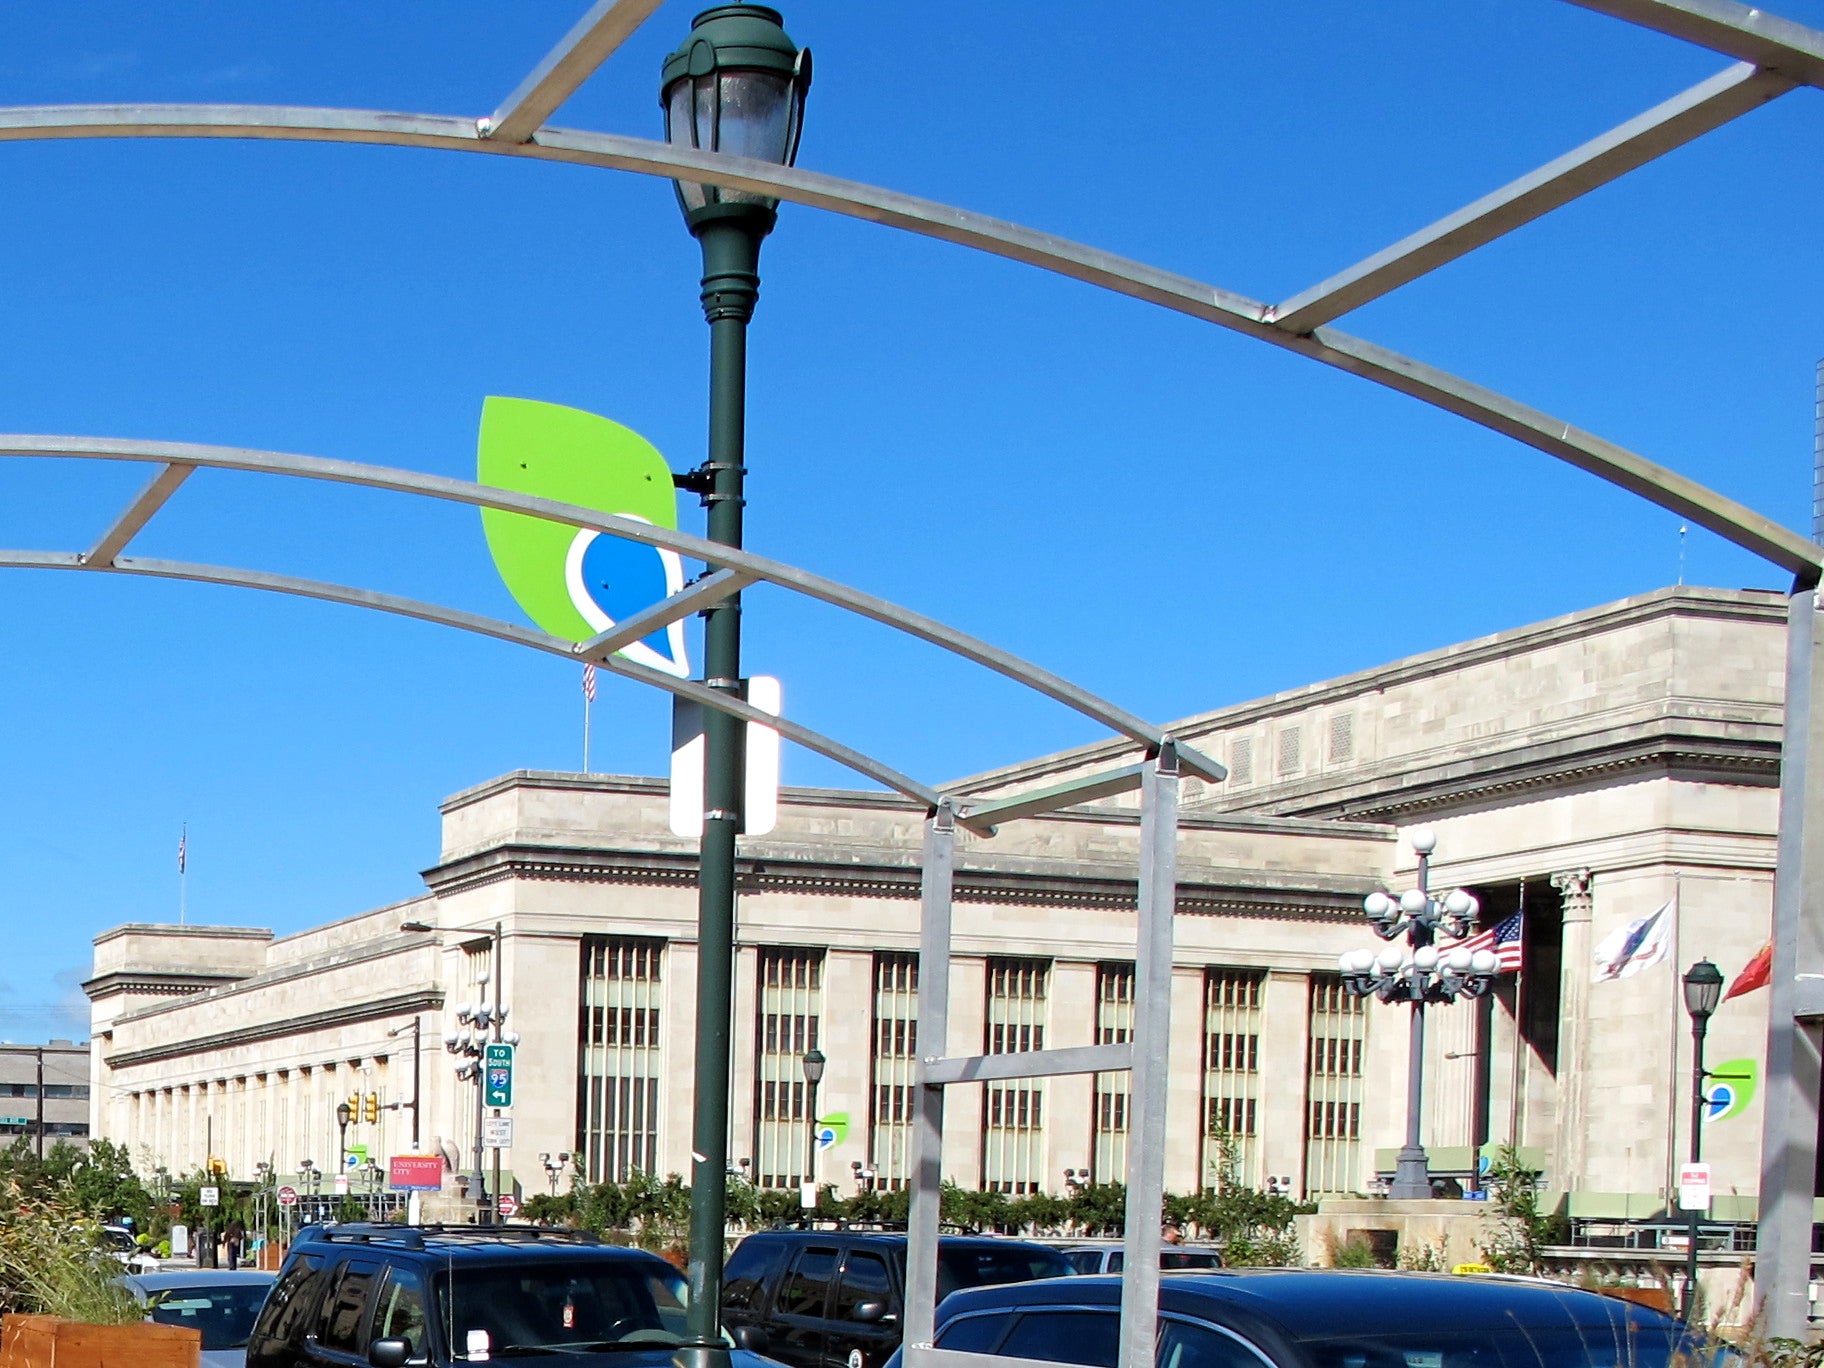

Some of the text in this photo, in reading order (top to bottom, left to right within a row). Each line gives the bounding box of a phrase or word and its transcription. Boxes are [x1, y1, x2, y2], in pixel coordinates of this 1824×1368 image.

[493, 1049, 506, 1058] TO
[488, 1058, 510, 1067] SOUTH
[491, 1073, 507, 1085] 95
